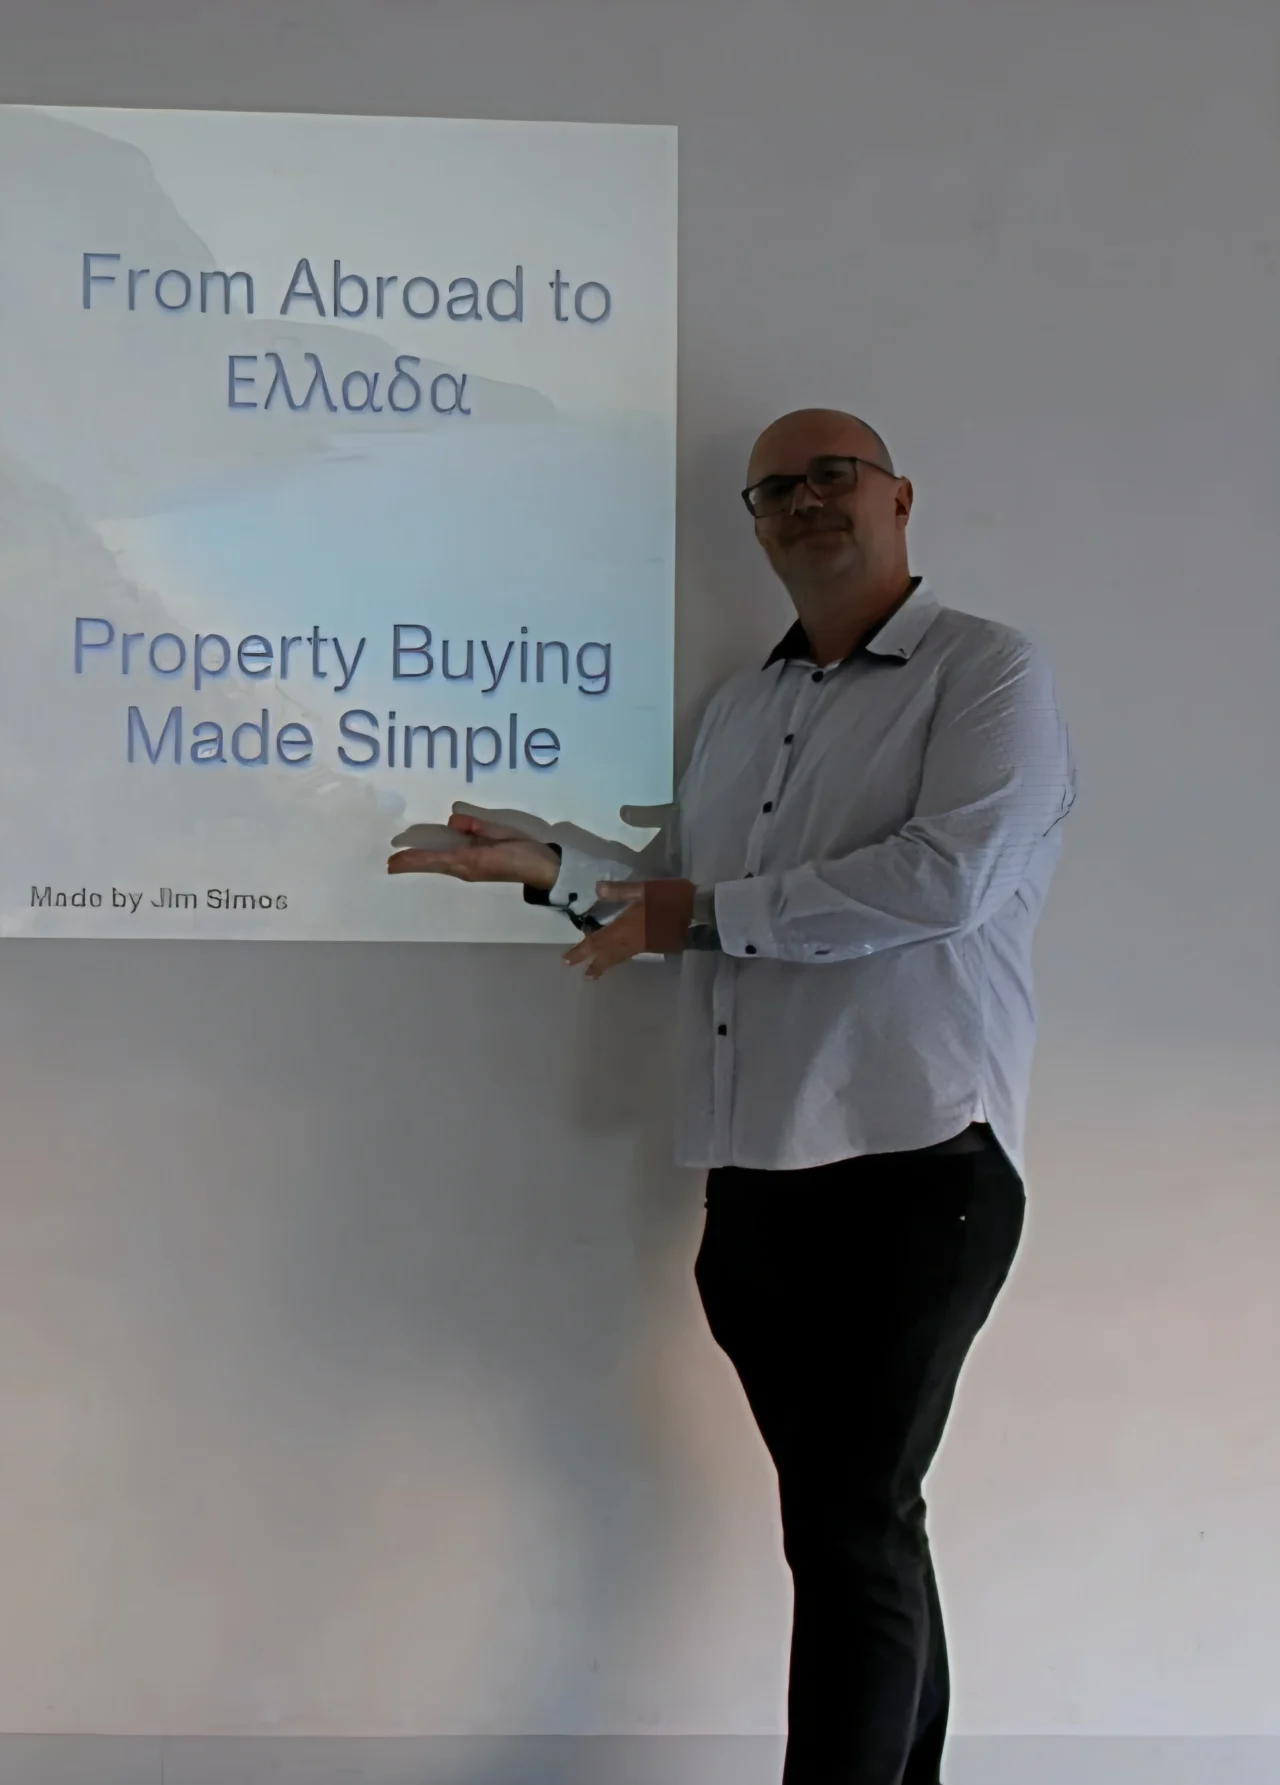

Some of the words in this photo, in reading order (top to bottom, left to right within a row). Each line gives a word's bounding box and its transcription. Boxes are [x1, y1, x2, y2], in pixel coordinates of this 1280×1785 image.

[82, 251, 255, 315] From
[279, 257, 524, 323] Abroad
[548, 268, 612, 324] to
[227, 351, 472, 416] Ελλαδα
[74, 616, 367, 693] Property
[391, 623, 612, 695] Buying
[126, 705, 314, 766] Made
[336, 708, 562, 784] Simple
[30, 885, 103, 908] Made
[111, 887, 144, 914] by
[150, 887, 198, 909] Jim
[206, 888, 288, 910] Simos
